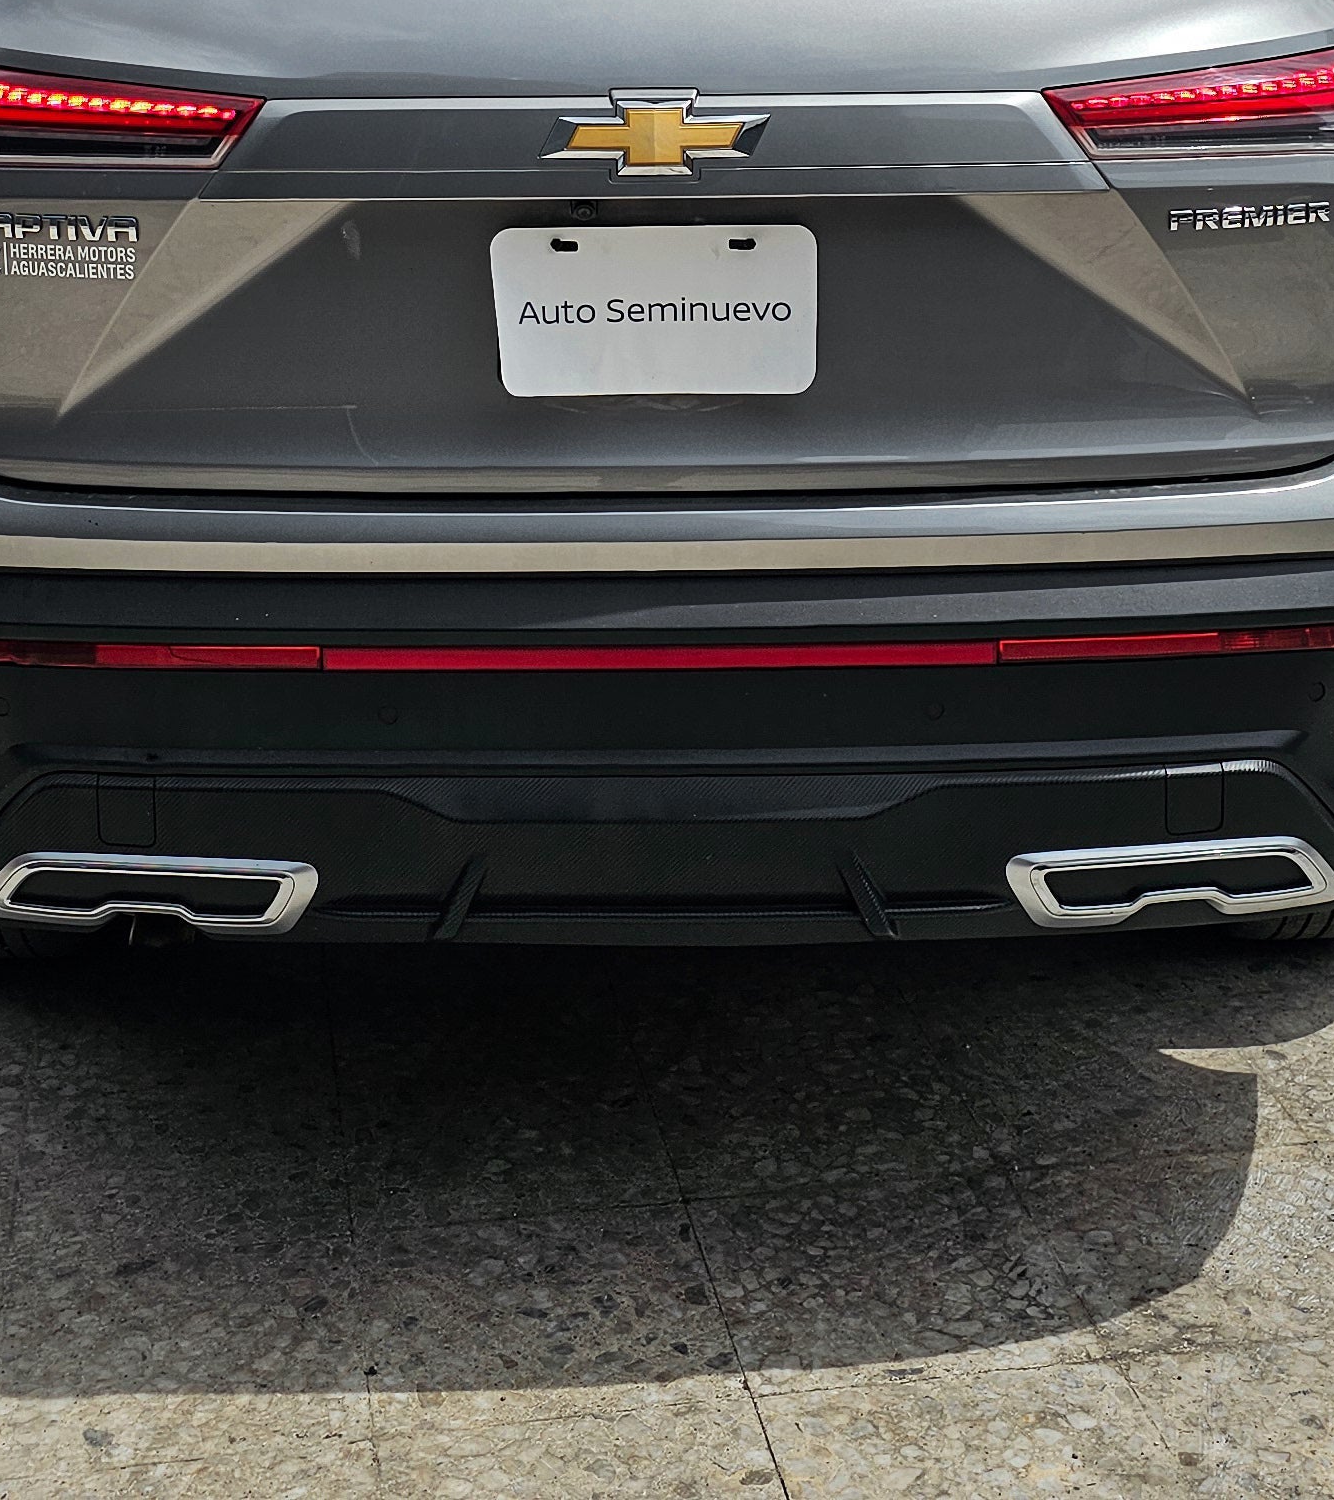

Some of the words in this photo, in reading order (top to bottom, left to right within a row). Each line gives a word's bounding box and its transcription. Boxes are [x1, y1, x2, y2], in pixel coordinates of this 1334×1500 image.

[1169, 201, 1331, 232] PREMIER
[10, 242, 75, 261] HERRERA
[77, 246, 136, 263] MOTORS
[11, 260, 135, 280] AGUASCALIENTES
[518, 301, 596, 325] Auto
[606, 297, 792, 324] Seminuevo
